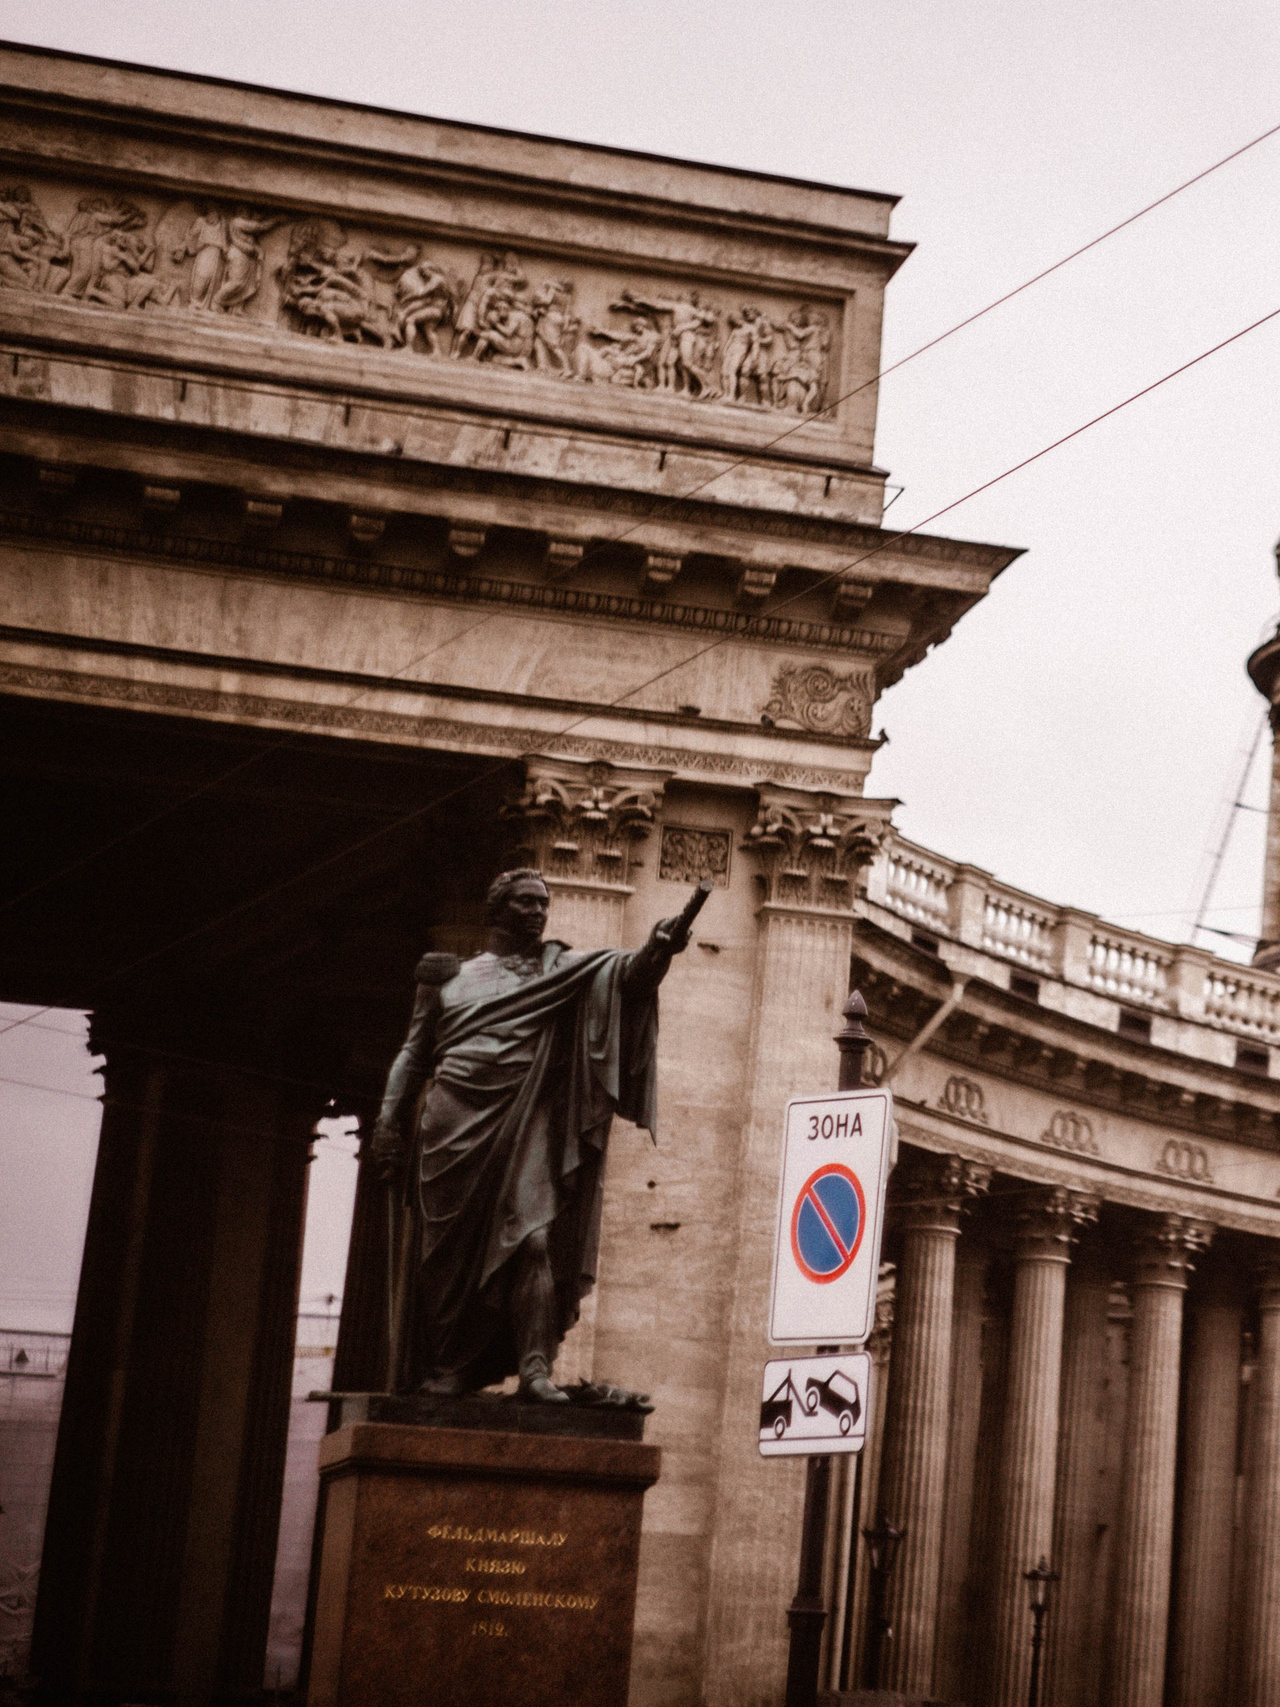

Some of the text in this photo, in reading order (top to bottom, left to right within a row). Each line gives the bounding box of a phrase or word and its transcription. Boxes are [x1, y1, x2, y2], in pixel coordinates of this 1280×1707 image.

[807, 1112, 863, 1141] ЗОНА
[427, 1524, 568, 1547] ФЕЛЬДМАРШАЛУ
[465, 1557, 526, 1575] КНЯЗЮ
[384, 1584, 600, 1610] КУТУЗОВУ СМОЛЕНСКОМУ
